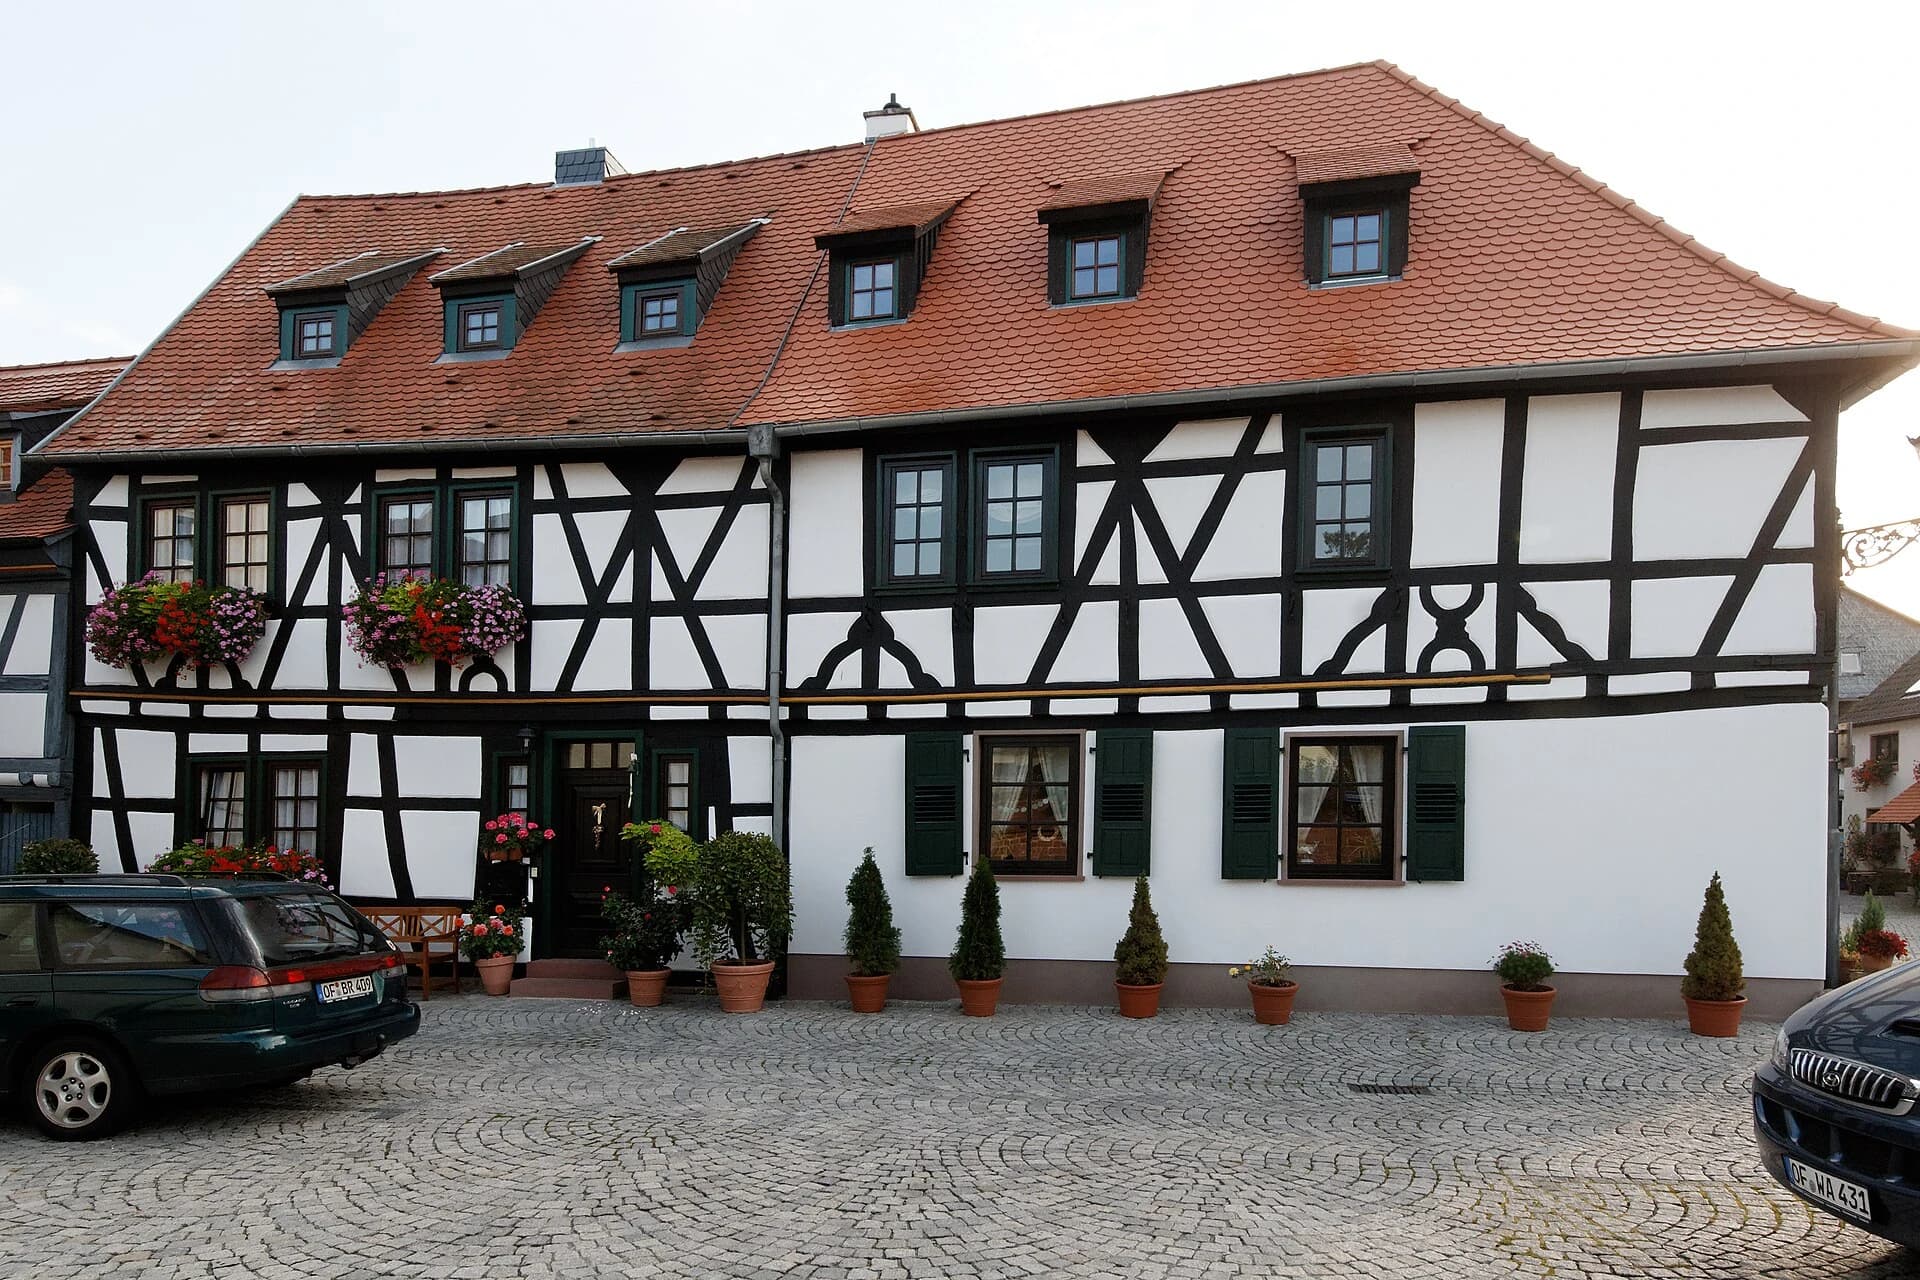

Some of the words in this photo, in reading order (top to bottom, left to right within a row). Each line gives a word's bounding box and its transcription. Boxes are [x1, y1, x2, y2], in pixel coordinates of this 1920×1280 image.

[323, 984, 335, 998] OF
[341, 981, 354, 994] BR
[356, 978, 371, 992] 409
[1791, 1163, 1807, 1186] OF
[1815, 1172, 1835, 1200] WA
[1838, 1184, 1869, 1215] 431
